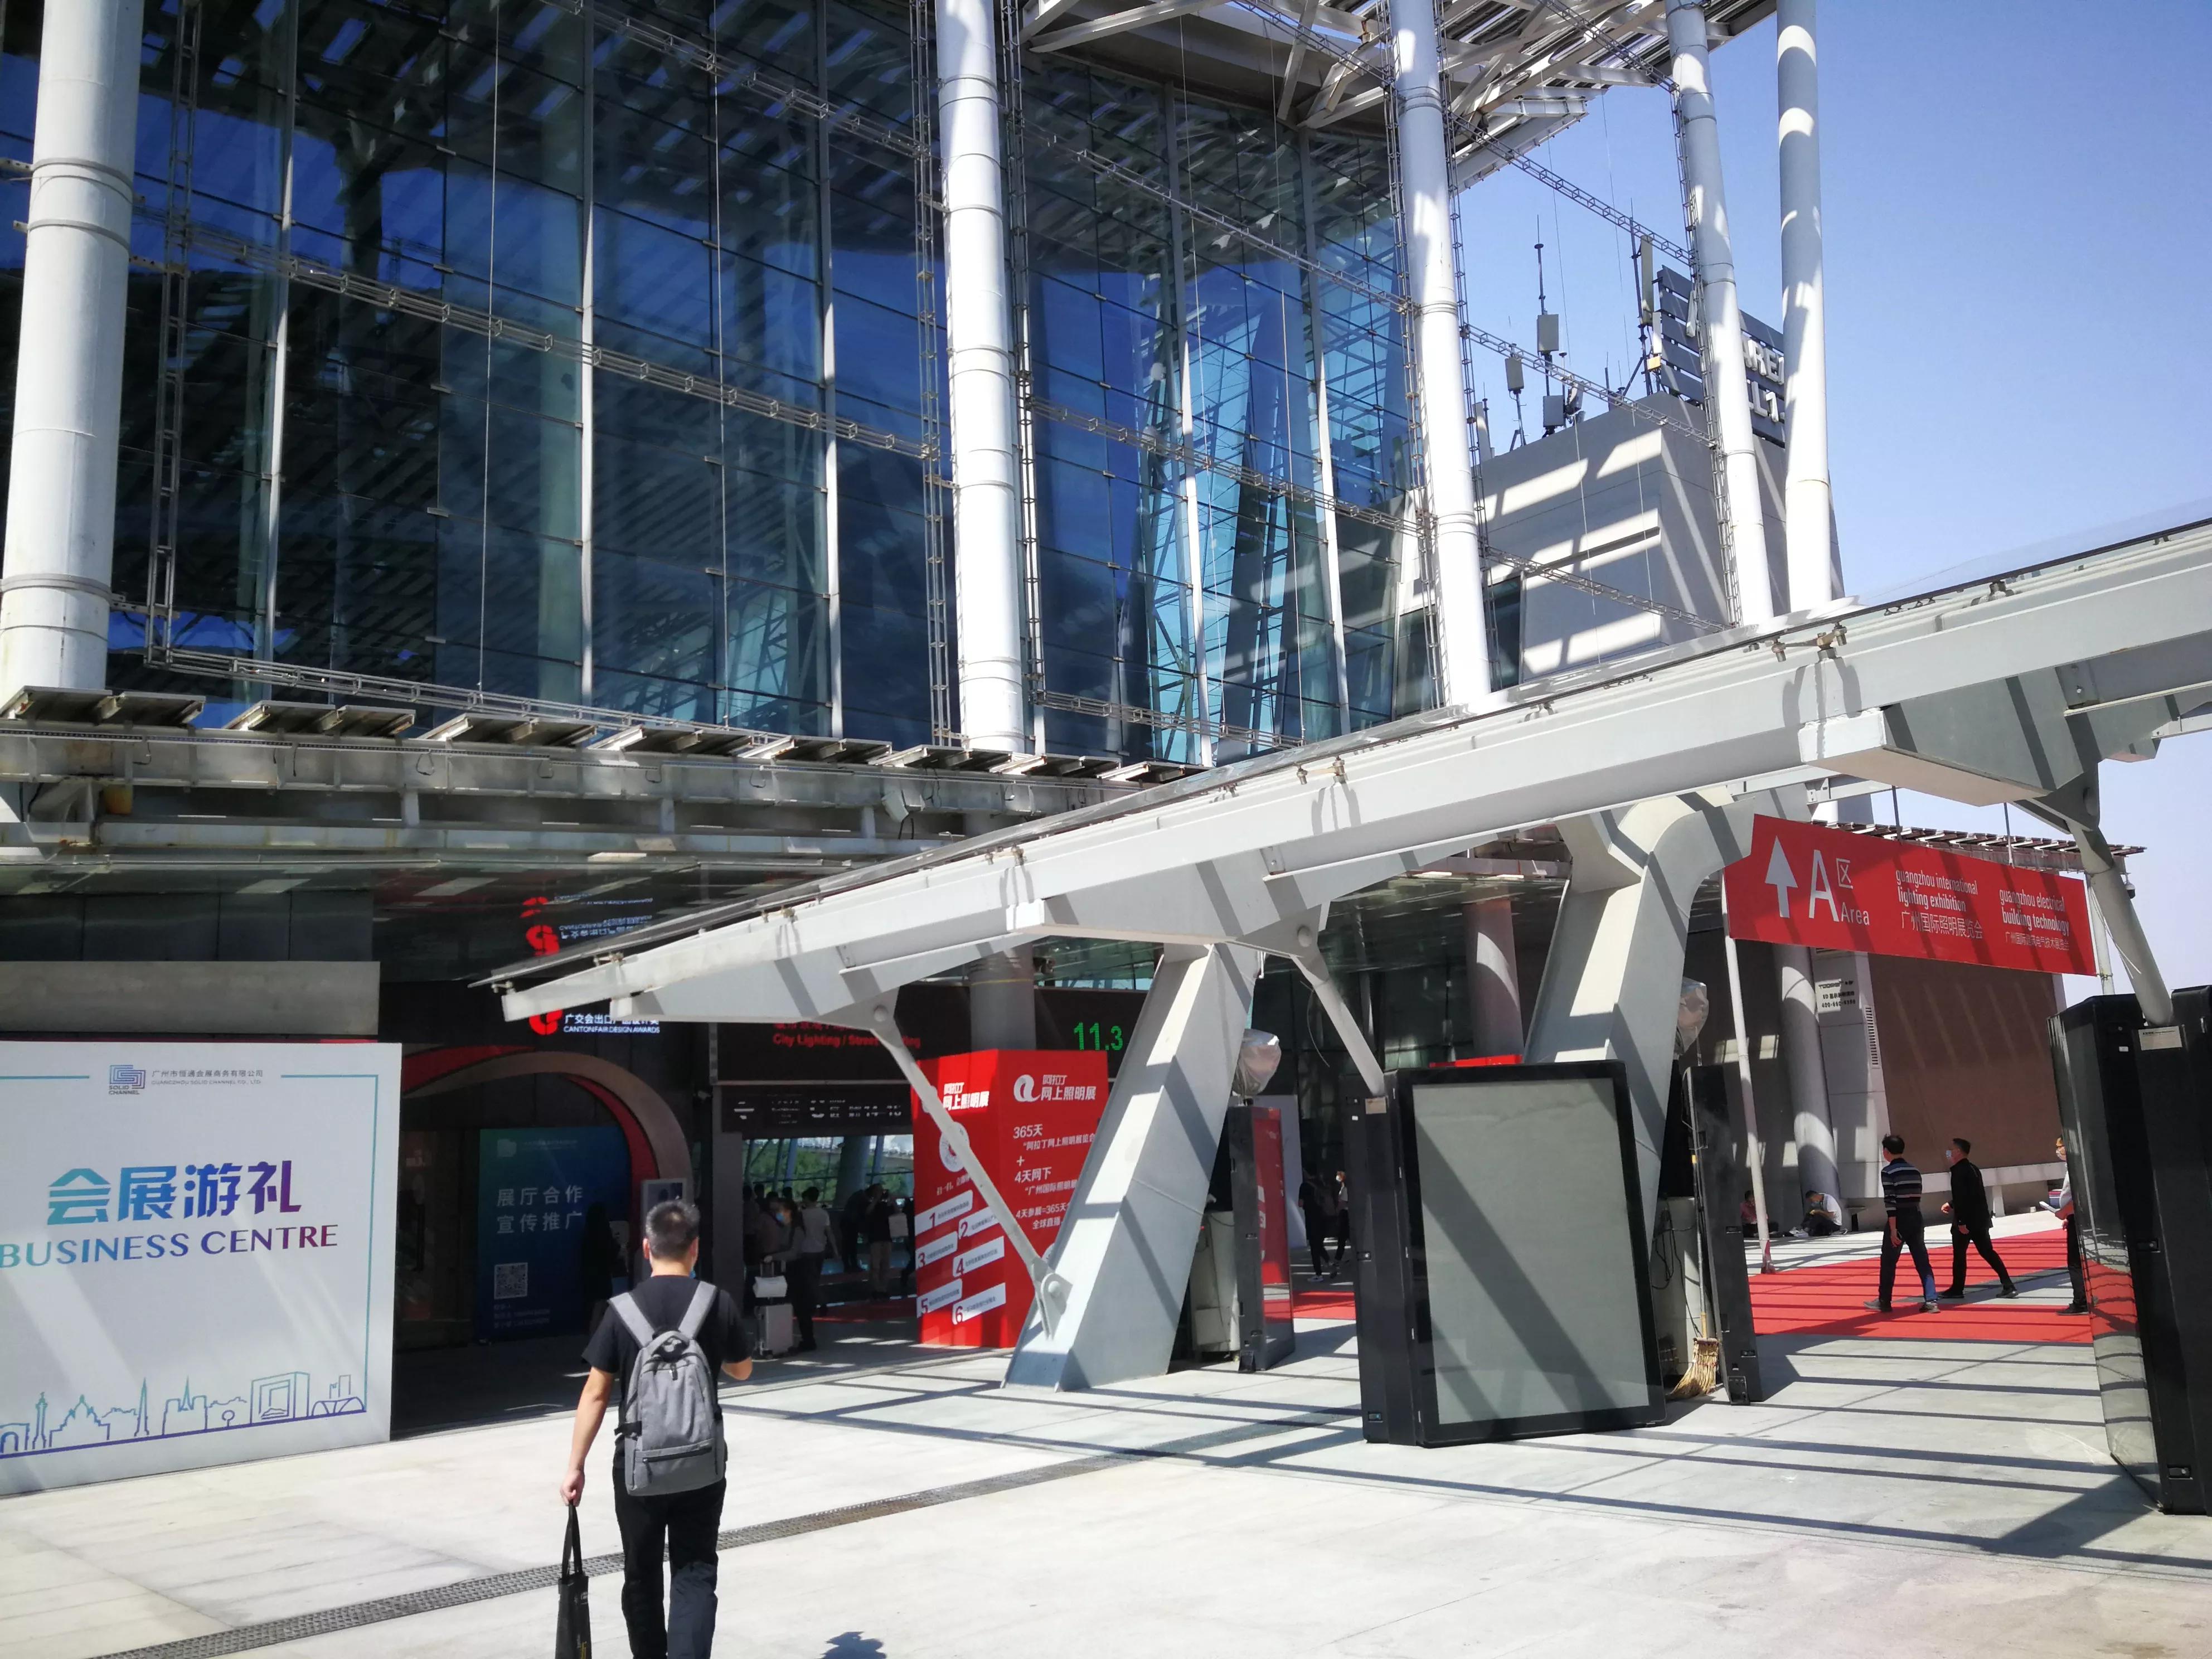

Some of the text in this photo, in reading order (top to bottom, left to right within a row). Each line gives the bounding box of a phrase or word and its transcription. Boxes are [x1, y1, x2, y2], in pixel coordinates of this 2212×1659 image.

[1809, 850, 1853, 921] A 区
[1896, 870, 1978, 895] guangzhou international
[1898, 886, 1967, 912] lighting exhibition
[1999, 889, 2065, 912] guangzhou electrical
[1841, 902, 1870, 925] Area
[2002, 907, 2070, 937] building technology
[1901, 911, 1983, 939] 广州国际照明展览会
[773, 1034, 794, 1047] City
[798, 1034, 841, 1047] Lighting
[1074, 1022, 1123, 1051] 11.3
[1042, 1074, 1068, 1085] 阿拉丁
[1041, 1086, 1097, 1101] 网上照明展
[1013, 1124, 1043, 1139] 365天
[1015, 1166, 1052, 1183] 4天网下
[47, 1160, 302, 1225] 会展游礼
[497, 1185, 583, 1206] 展厅合作
[929, 1212, 935, 1228] 1
[1016, 1202, 1068, 1219] 4天参展=365天
[497, 1211, 582, 1234] 宣传推广
[961, 1221, 968, 1239] 2
[0, 1224, 338, 1268] BUSINESS CENTRE
[956, 1258, 965, 1275] 4
[955, 1306, 963, 1323] 6
